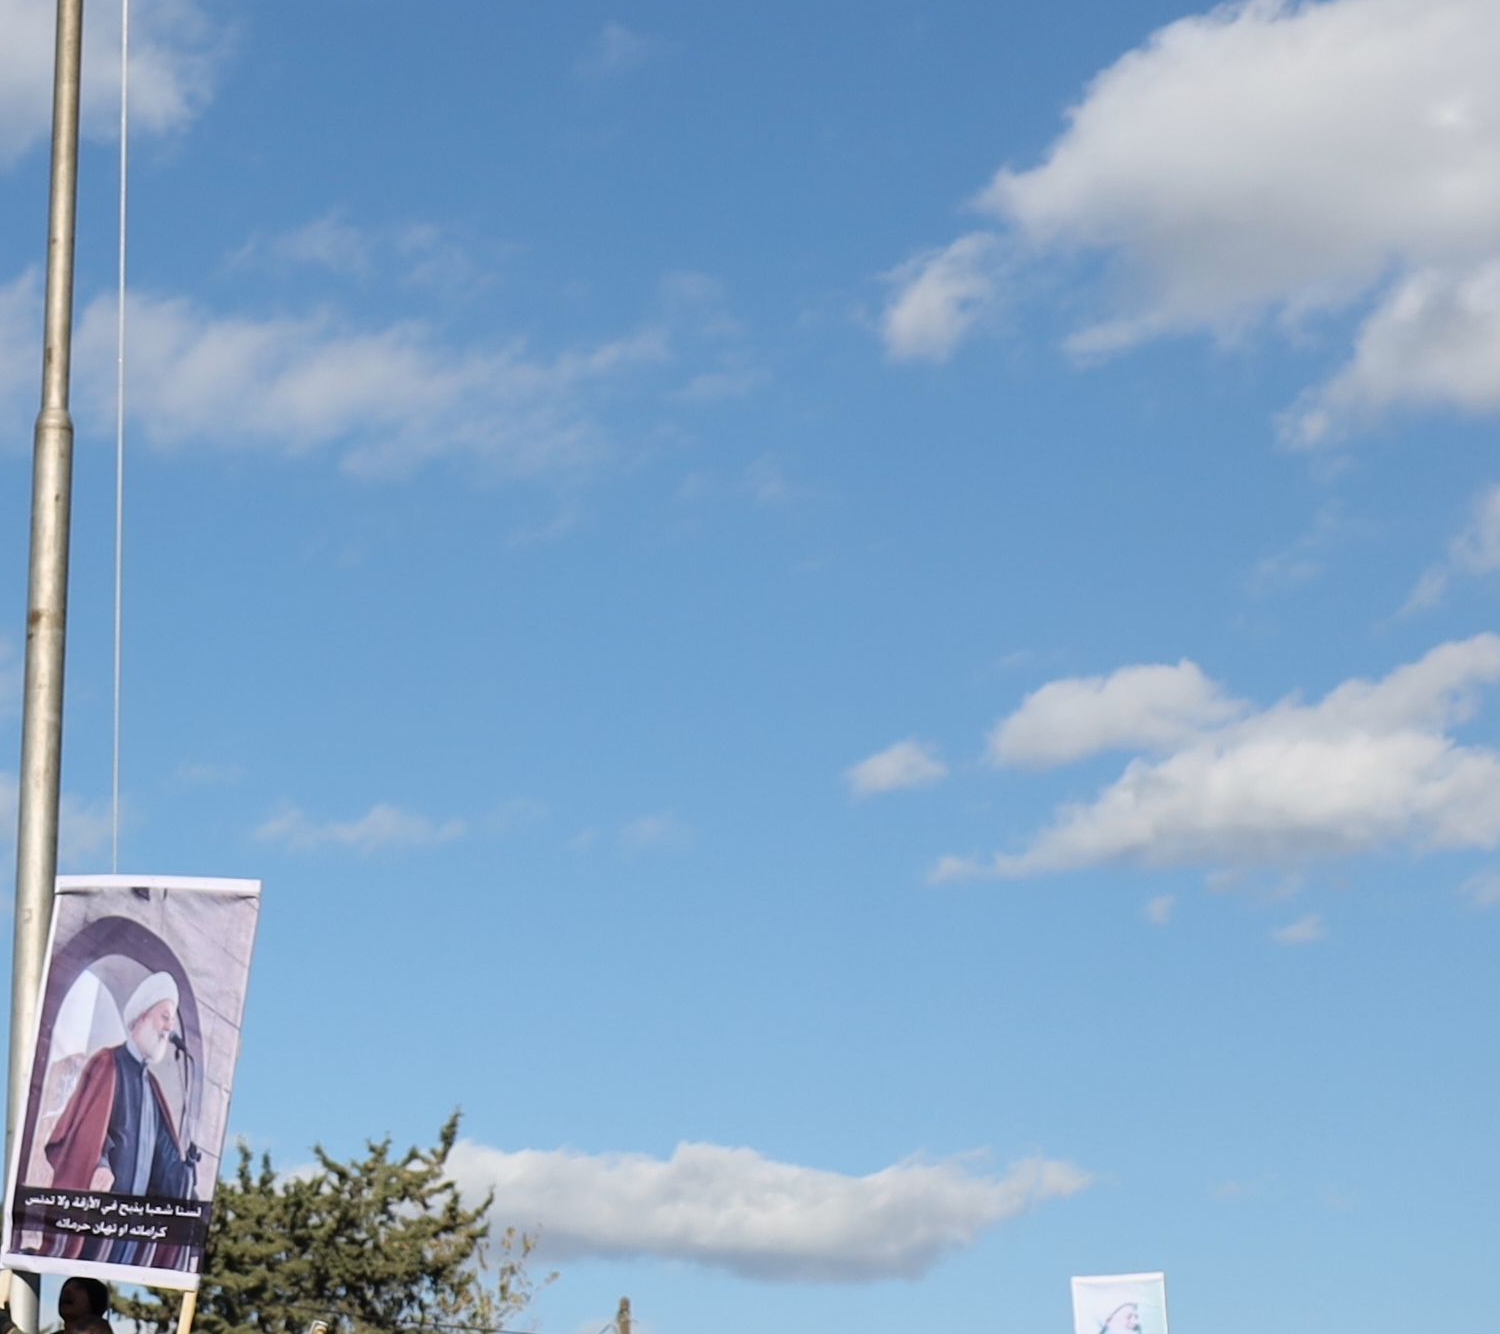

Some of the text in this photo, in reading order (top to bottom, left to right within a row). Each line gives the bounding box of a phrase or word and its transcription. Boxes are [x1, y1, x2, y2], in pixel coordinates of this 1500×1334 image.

[56, 1194, 71, 1210] ولا
[100, 1199, 118, 1216] في
[118, 1200, 145, 1216] يذبح
[145, 1202, 174, 1216] شعبا
[175, 1204, 202, 1219] لسنا
